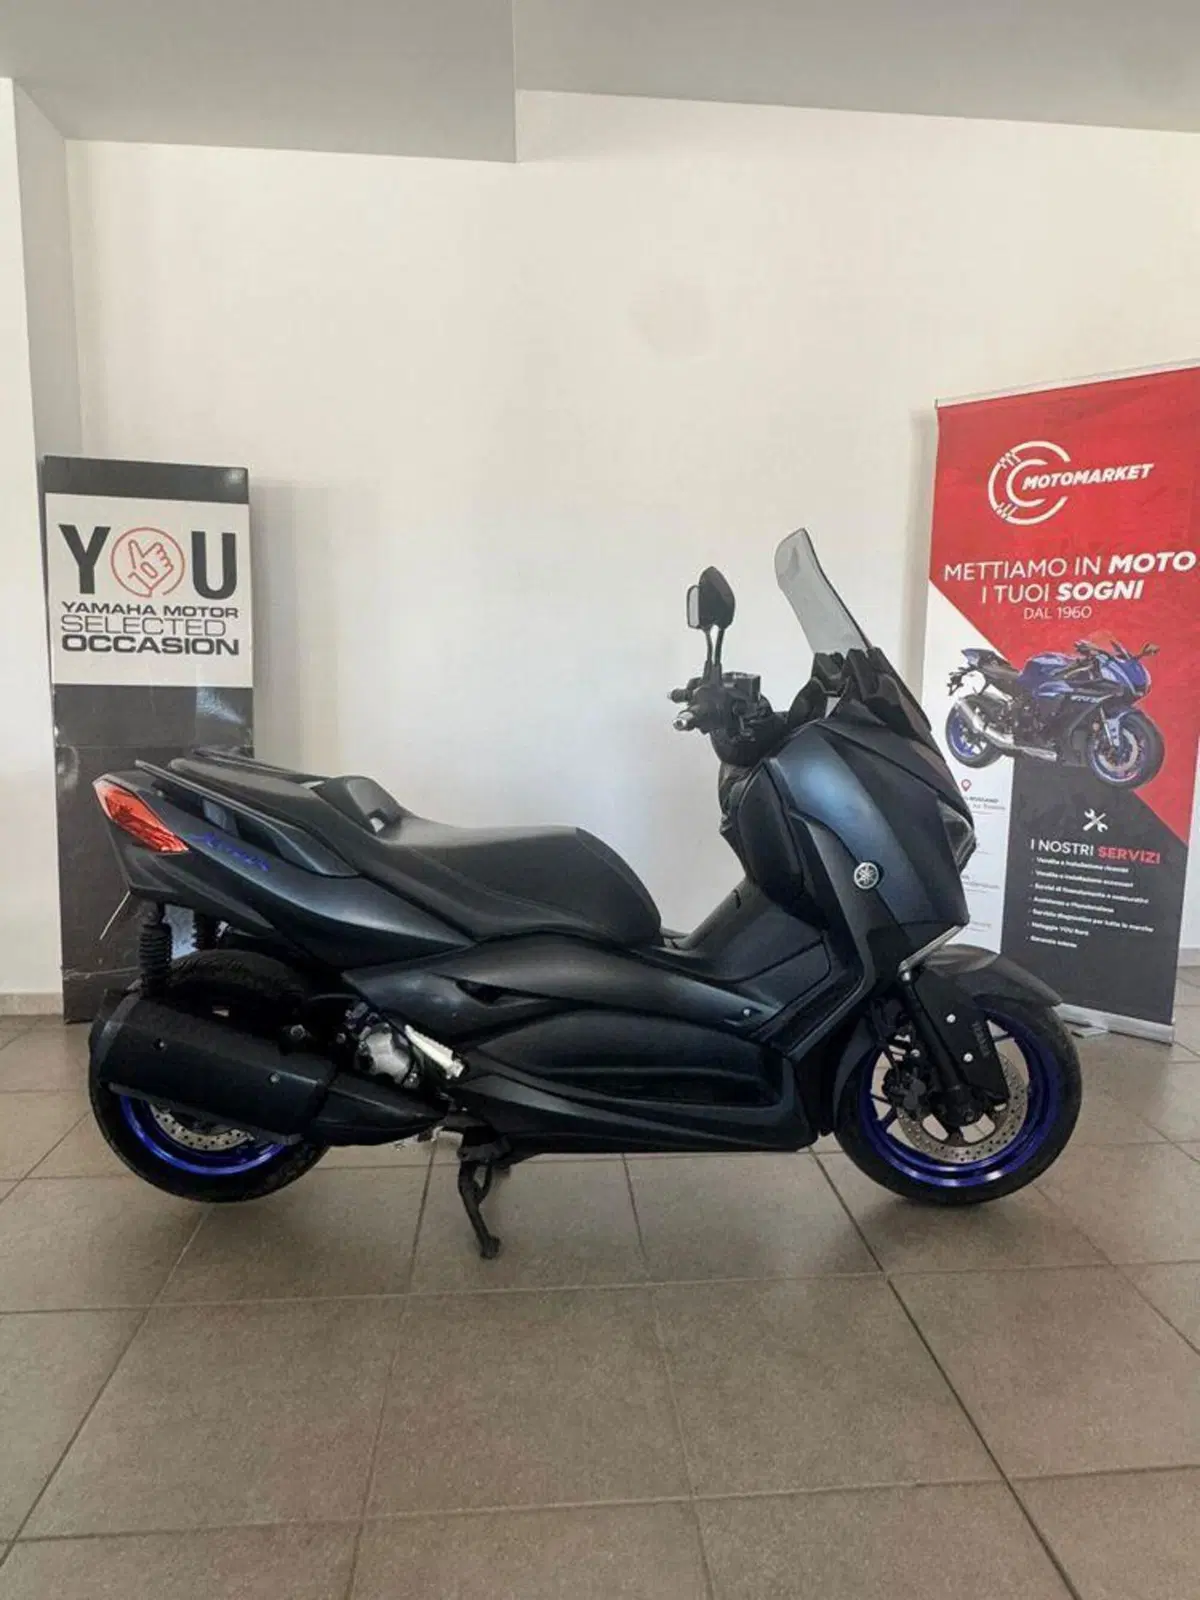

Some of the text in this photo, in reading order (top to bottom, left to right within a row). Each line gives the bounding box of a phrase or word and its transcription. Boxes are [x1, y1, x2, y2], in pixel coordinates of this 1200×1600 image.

[1022, 463, 1154, 490] MOTOMARKET
[944, 551, 1196, 582] METTIAMO IN MOTO
[982, 580, 1144, 604] I TUOI SOGNI
[62, 601, 239, 618] YAMAHA MOTOR
[1023, 606, 1092, 620] DAL 1960
[61, 615, 226, 637] SELECTED
[62, 634, 239, 655] OCCASION
[1030, 838, 1161, 864] I NOSTRI SERVIZI
